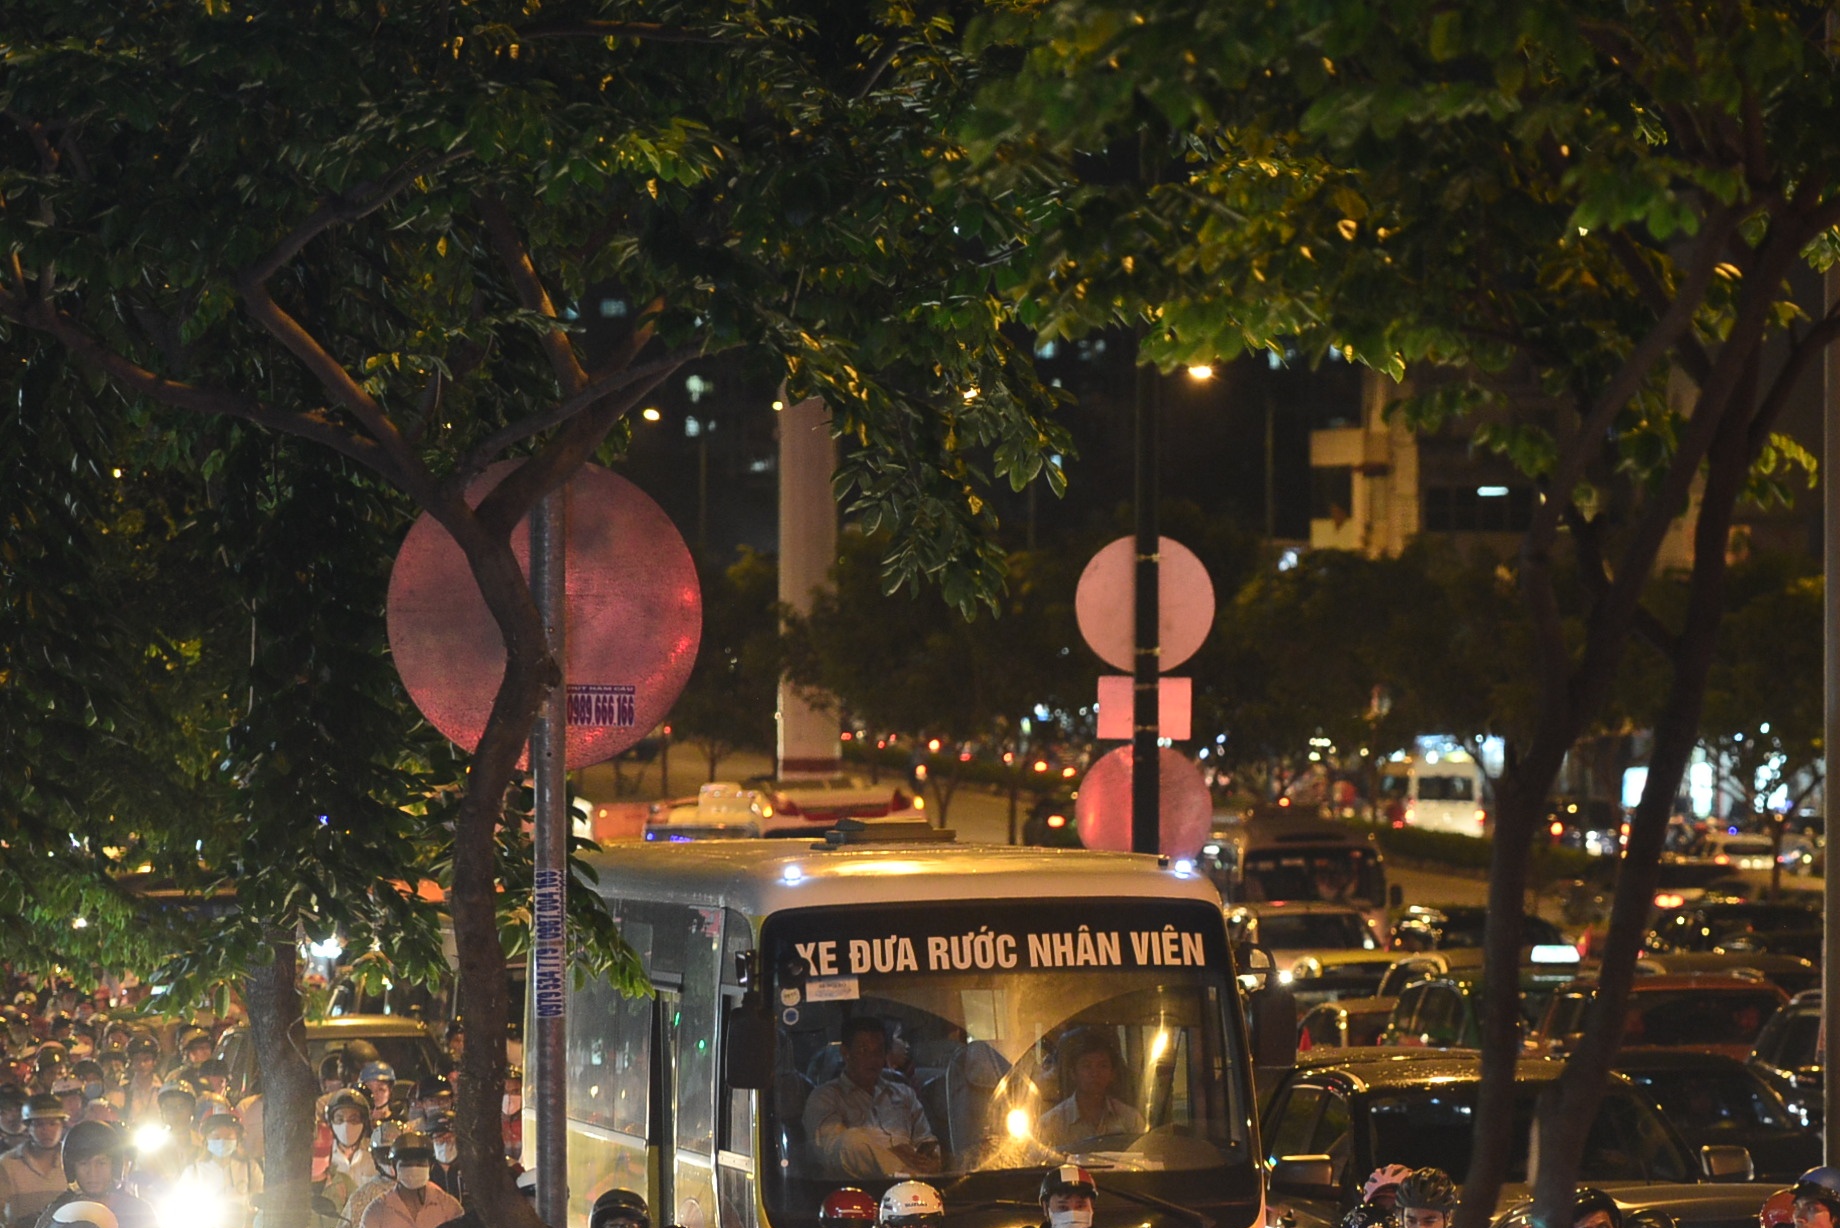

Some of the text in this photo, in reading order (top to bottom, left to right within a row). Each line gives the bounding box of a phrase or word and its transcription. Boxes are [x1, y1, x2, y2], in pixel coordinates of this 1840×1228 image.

[567, 694, 634, 726] 0989.666.166
[795, 924, 1206, 976] XE ĐƯA RƯỚC NHÂN VIÊN
